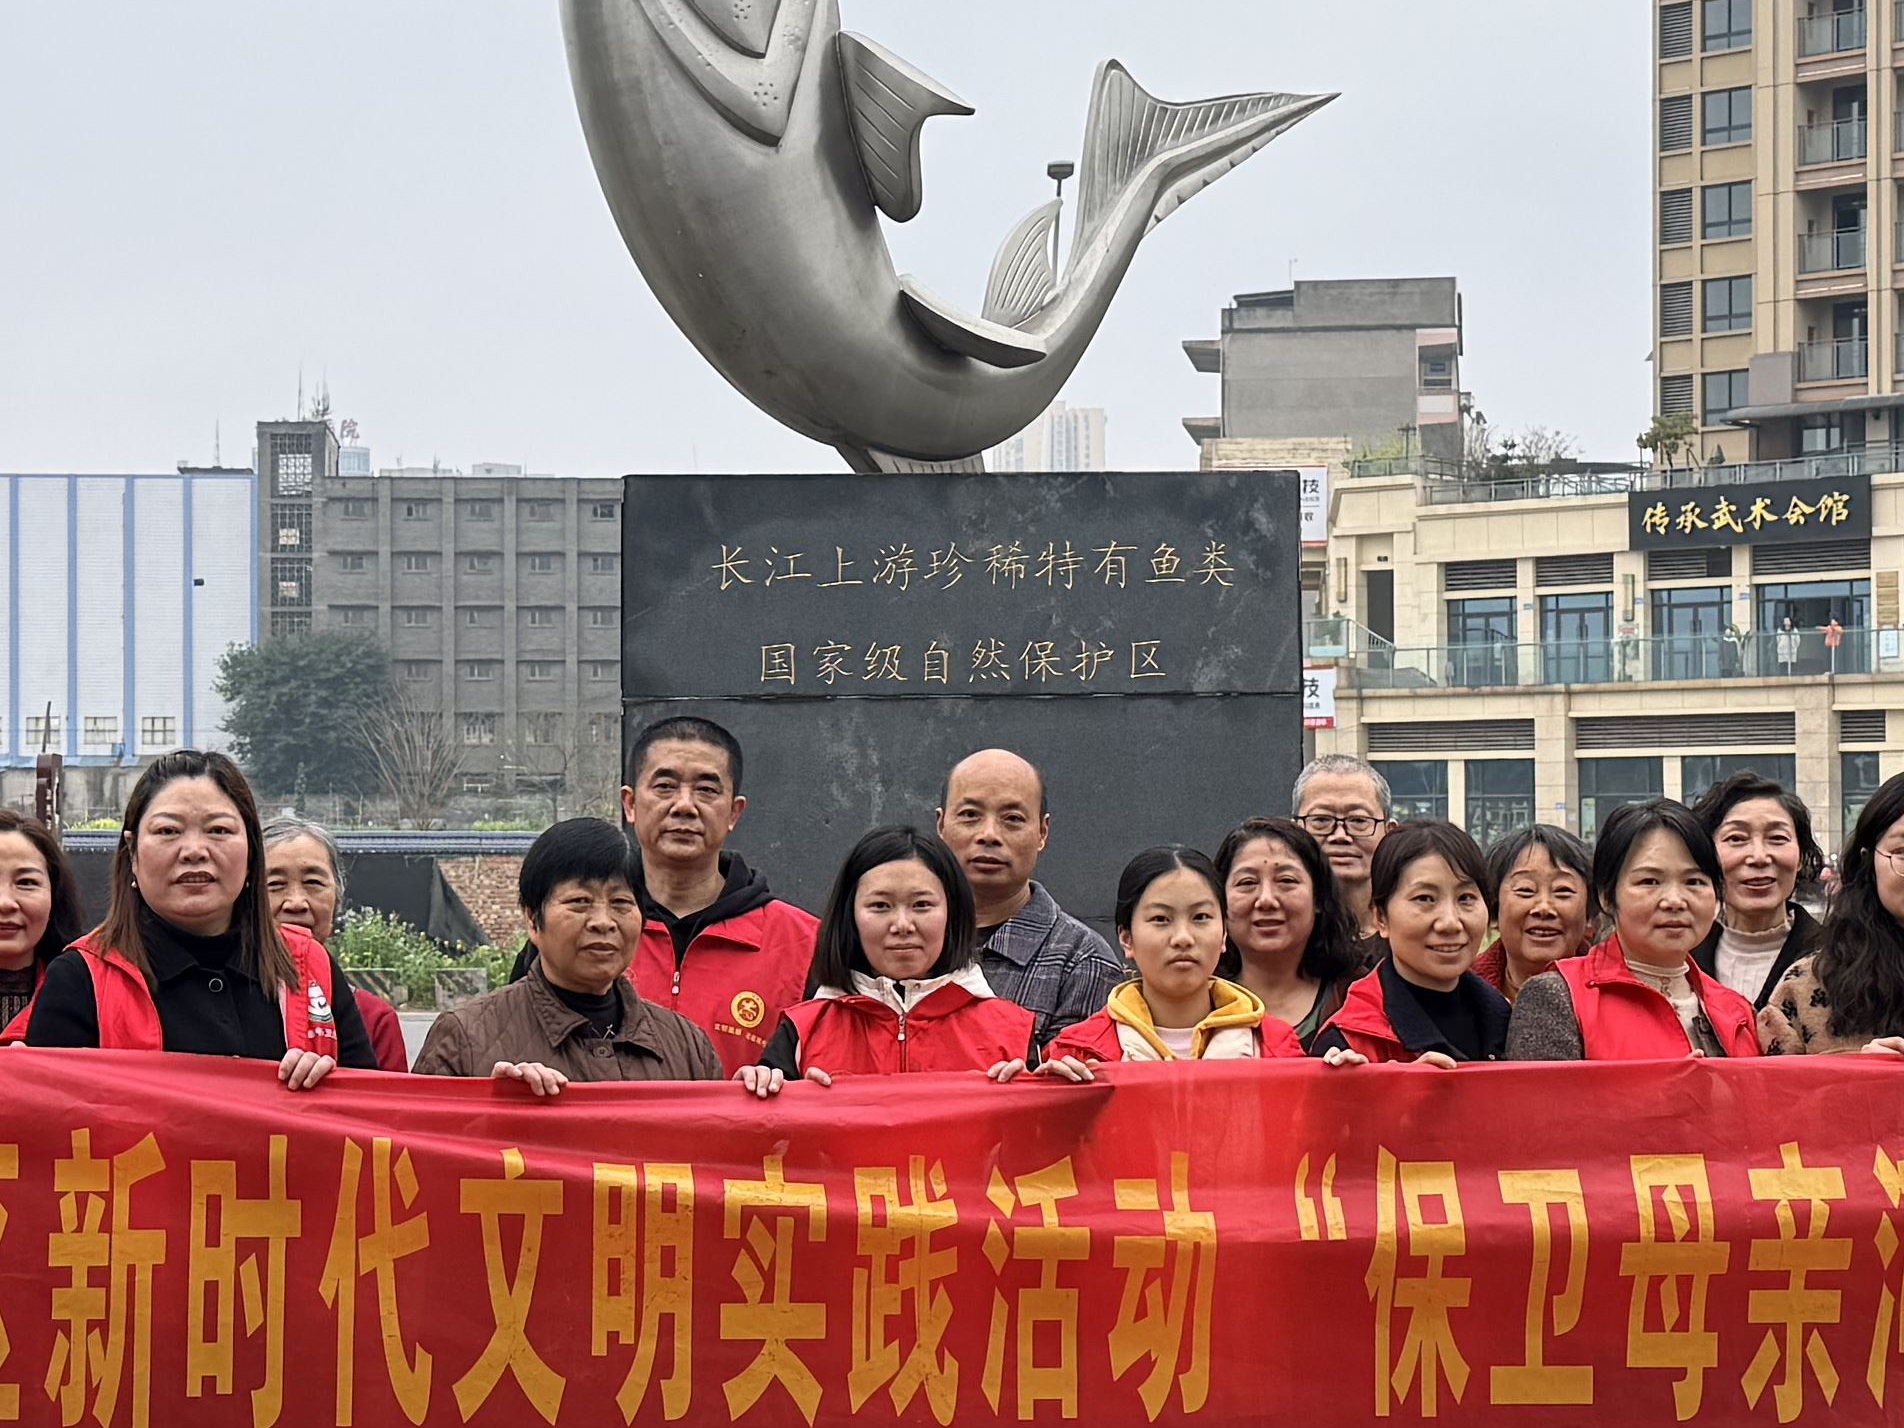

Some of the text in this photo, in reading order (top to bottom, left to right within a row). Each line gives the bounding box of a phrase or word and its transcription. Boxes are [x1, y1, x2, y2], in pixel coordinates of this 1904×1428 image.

[1642, 490, 1852, 535] 传承武术会馆
[710, 538, 1237, 592] 长江上游珍稀特有鱼类
[759, 638, 1169, 687] 国家级自然保护区
